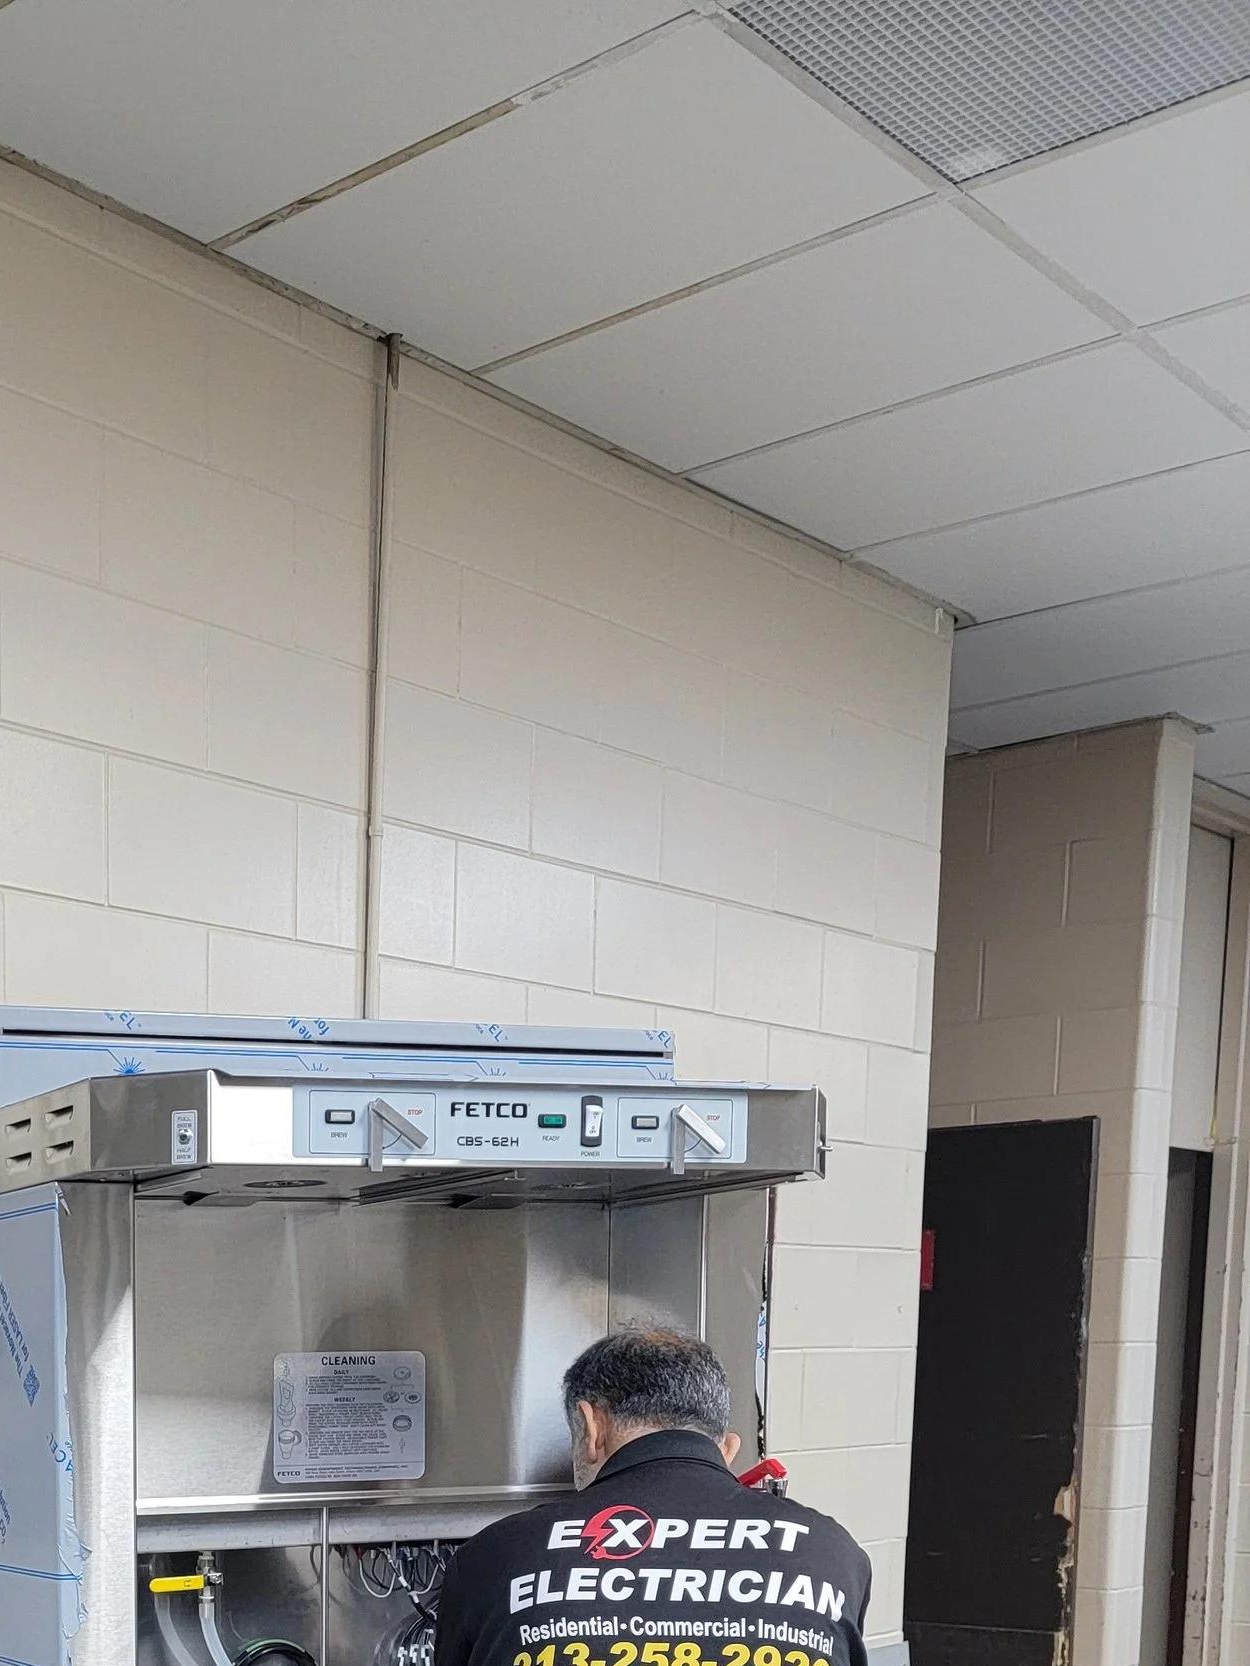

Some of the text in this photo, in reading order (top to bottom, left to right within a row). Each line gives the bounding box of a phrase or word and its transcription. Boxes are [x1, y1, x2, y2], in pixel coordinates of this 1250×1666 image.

[451, 1101, 528, 1119] FETCO
[330, 1131, 349, 1139] BREW
[456, 1136, 520, 1148] CBS-62H
[321, 1355, 376, 1366] CLEANING
[546, 1517, 810, 1552] EXPERT
[510, 1567, 846, 1622] ELECTRICIAN
